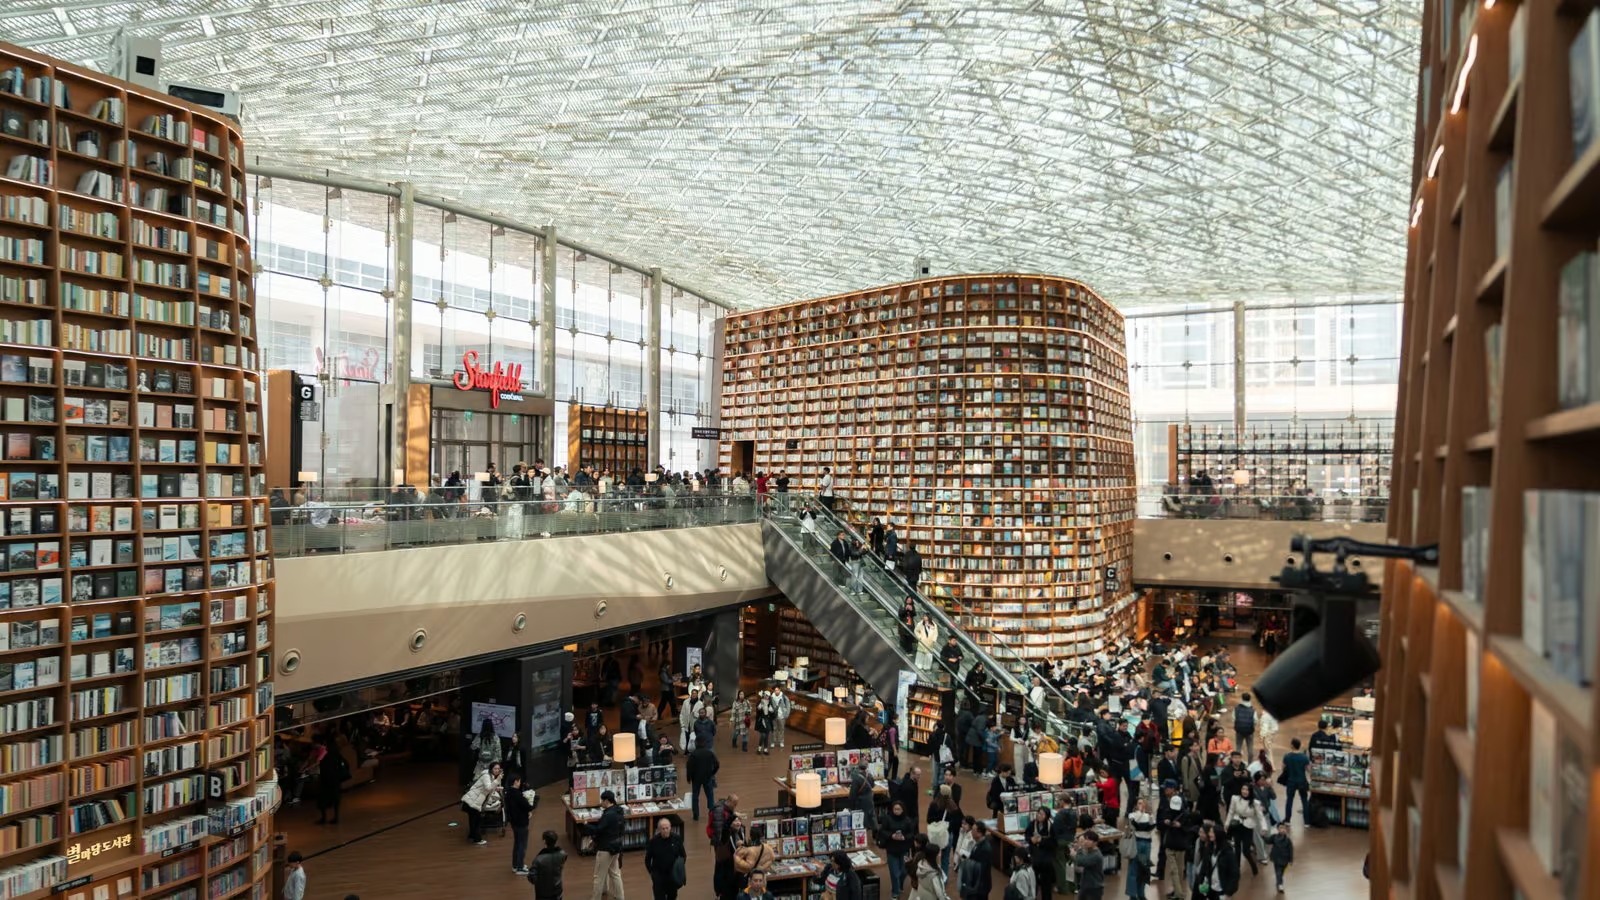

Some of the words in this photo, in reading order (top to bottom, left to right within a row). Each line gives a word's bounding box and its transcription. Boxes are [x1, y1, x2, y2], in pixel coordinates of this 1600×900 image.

[453, 349, 522, 408] Starfield
[301, 386, 312, 399] G
[1107, 569, 1115, 578] C
[210, 776, 221, 797] B
